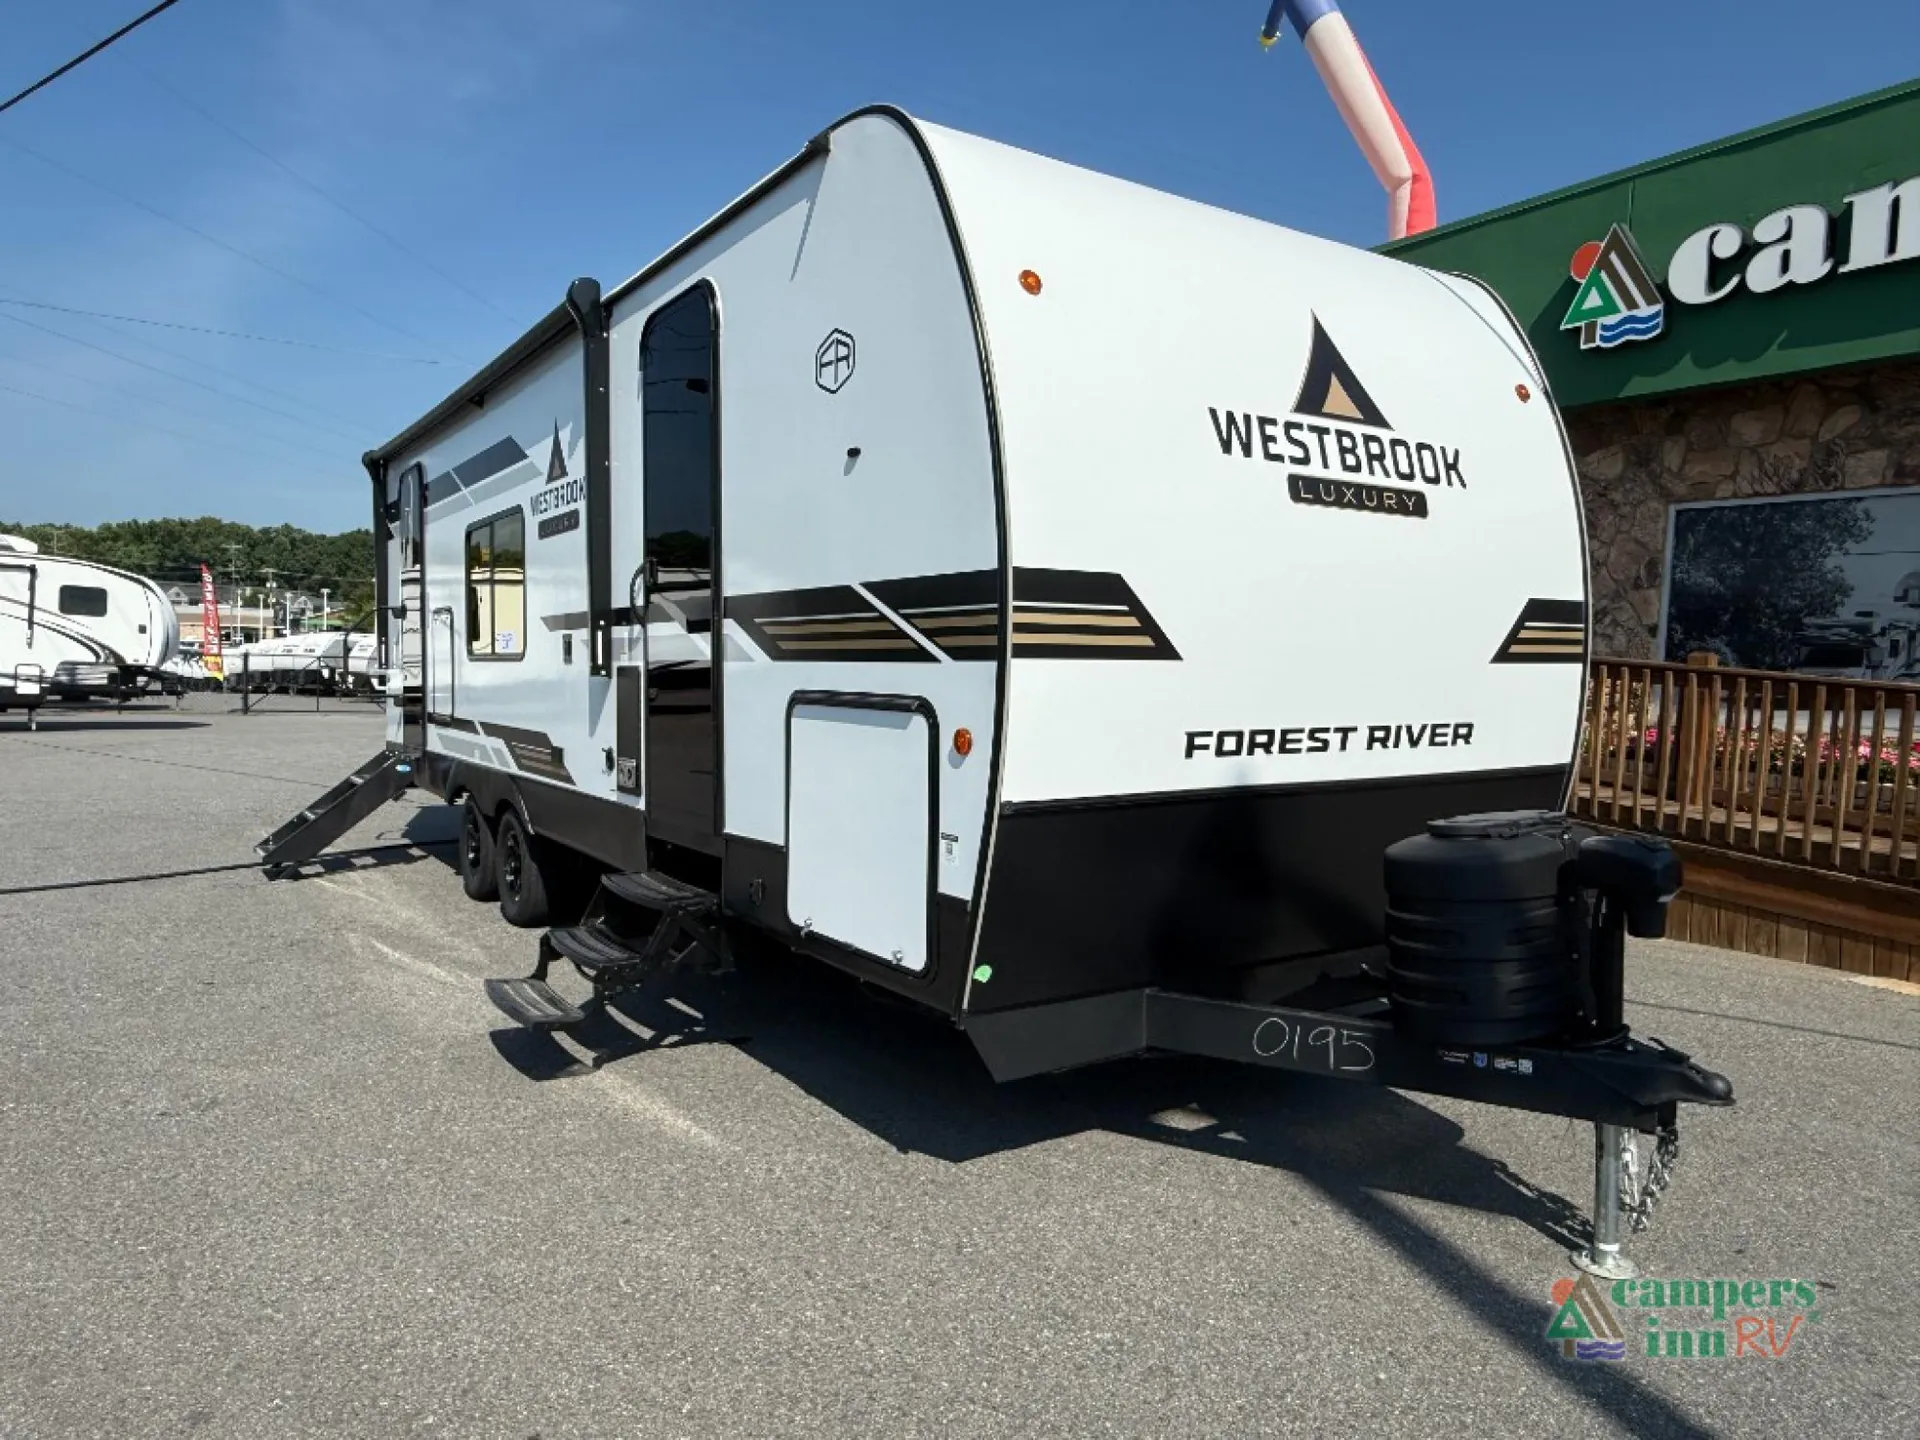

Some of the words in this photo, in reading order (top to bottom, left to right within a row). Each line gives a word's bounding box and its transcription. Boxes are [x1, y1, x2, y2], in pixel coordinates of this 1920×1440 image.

[1207, 406, 1467, 490] WESTBROOK
[1298, 479, 1417, 511] LUXURY
[1184, 725, 1358, 759] FOREST
[1366, 721, 1474, 750] RIVER
[1252, 1017, 1375, 1071] 0195
